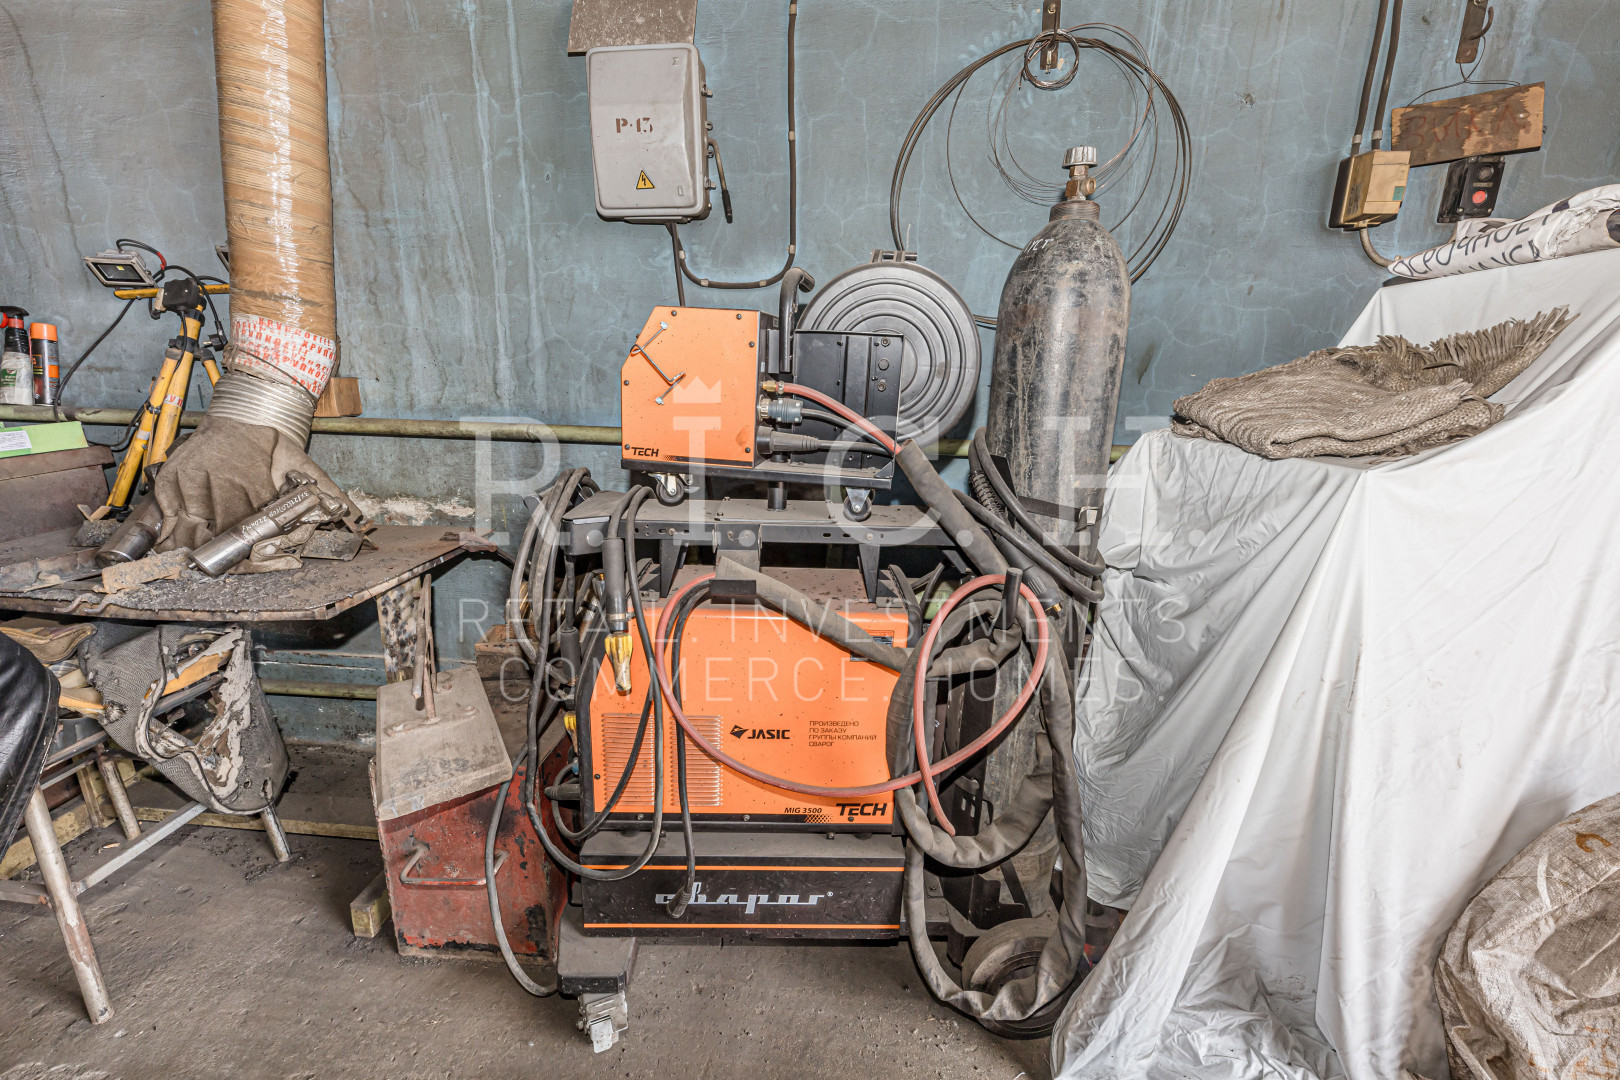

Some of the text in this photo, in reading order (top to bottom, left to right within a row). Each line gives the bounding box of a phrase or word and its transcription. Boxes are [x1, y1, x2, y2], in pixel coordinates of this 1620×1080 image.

[631, 447, 659, 457] TECH
[809, 720, 860, 728] ПРОИЗВЕДЕНО
[747, 729, 790, 740] JASIC
[836, 803, 887, 816] TECH
